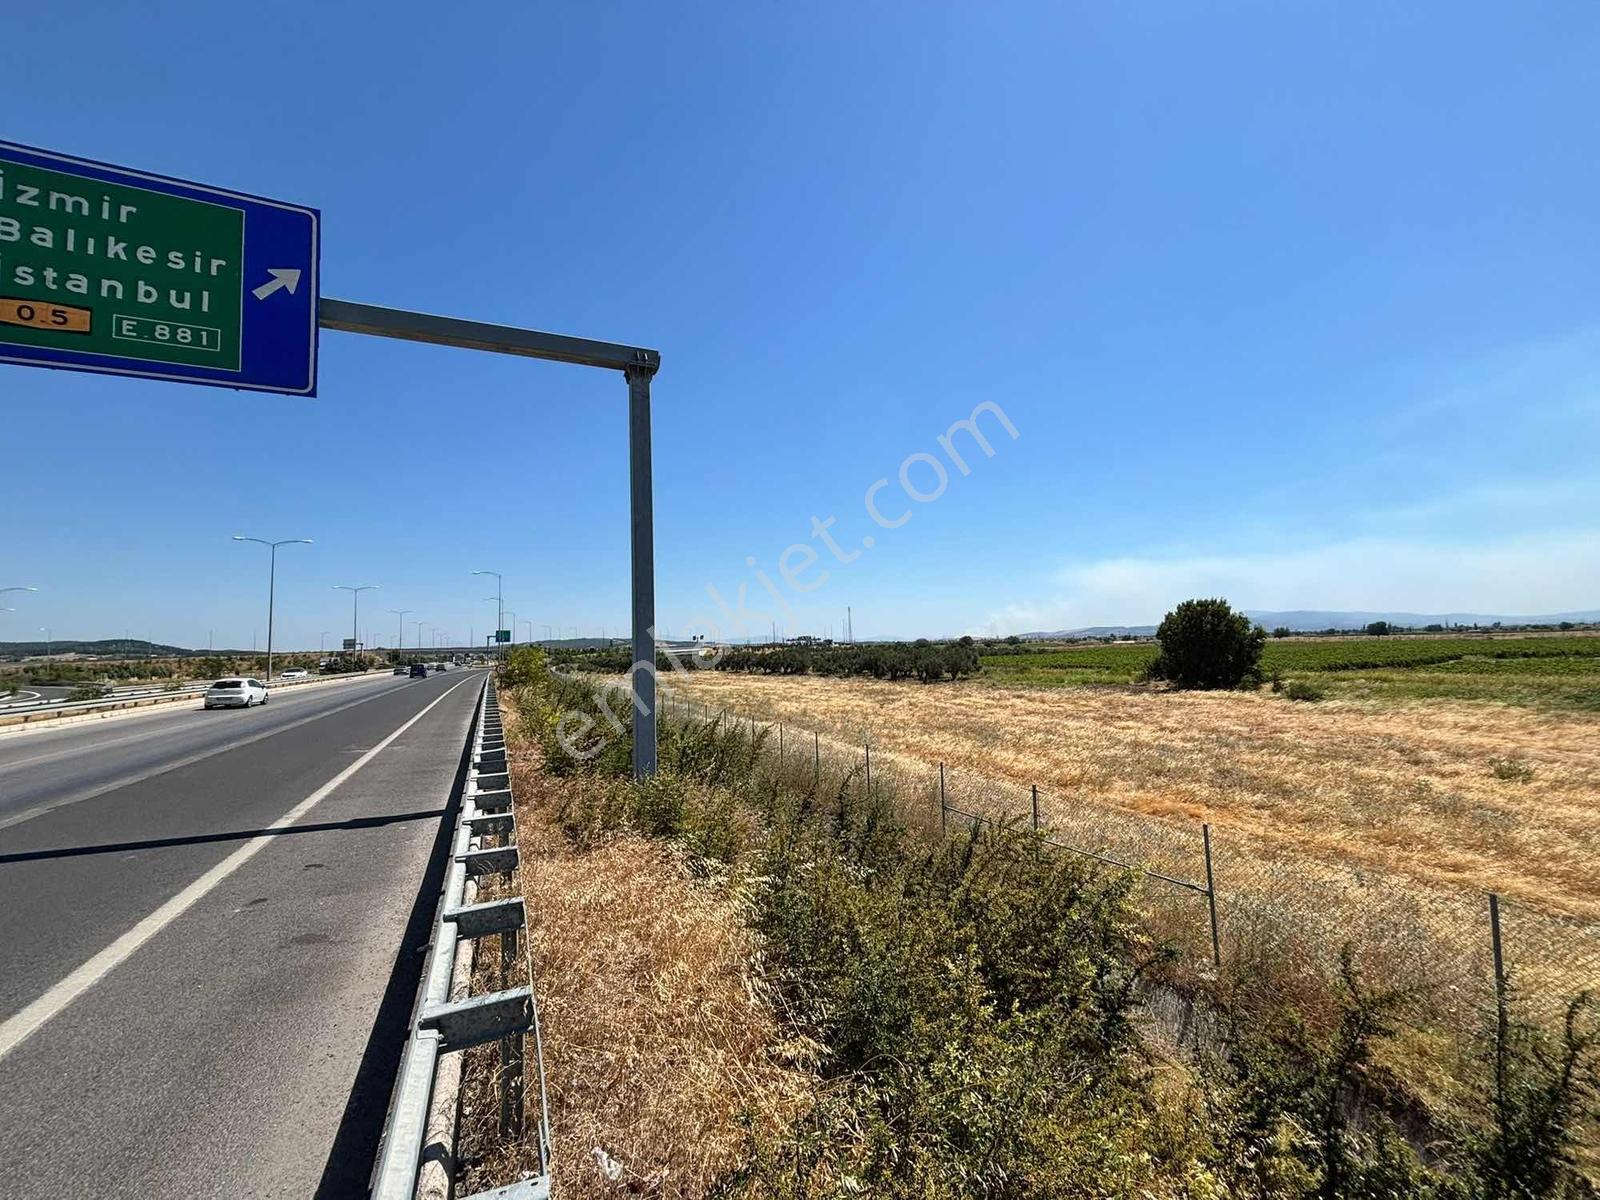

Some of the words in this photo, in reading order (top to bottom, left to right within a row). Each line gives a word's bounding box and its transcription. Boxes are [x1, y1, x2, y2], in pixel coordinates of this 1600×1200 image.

[0, 216, 226, 276] Balıkesir
[0, 252, 209, 312] stanbul
[121, 320, 207, 346] E.881
